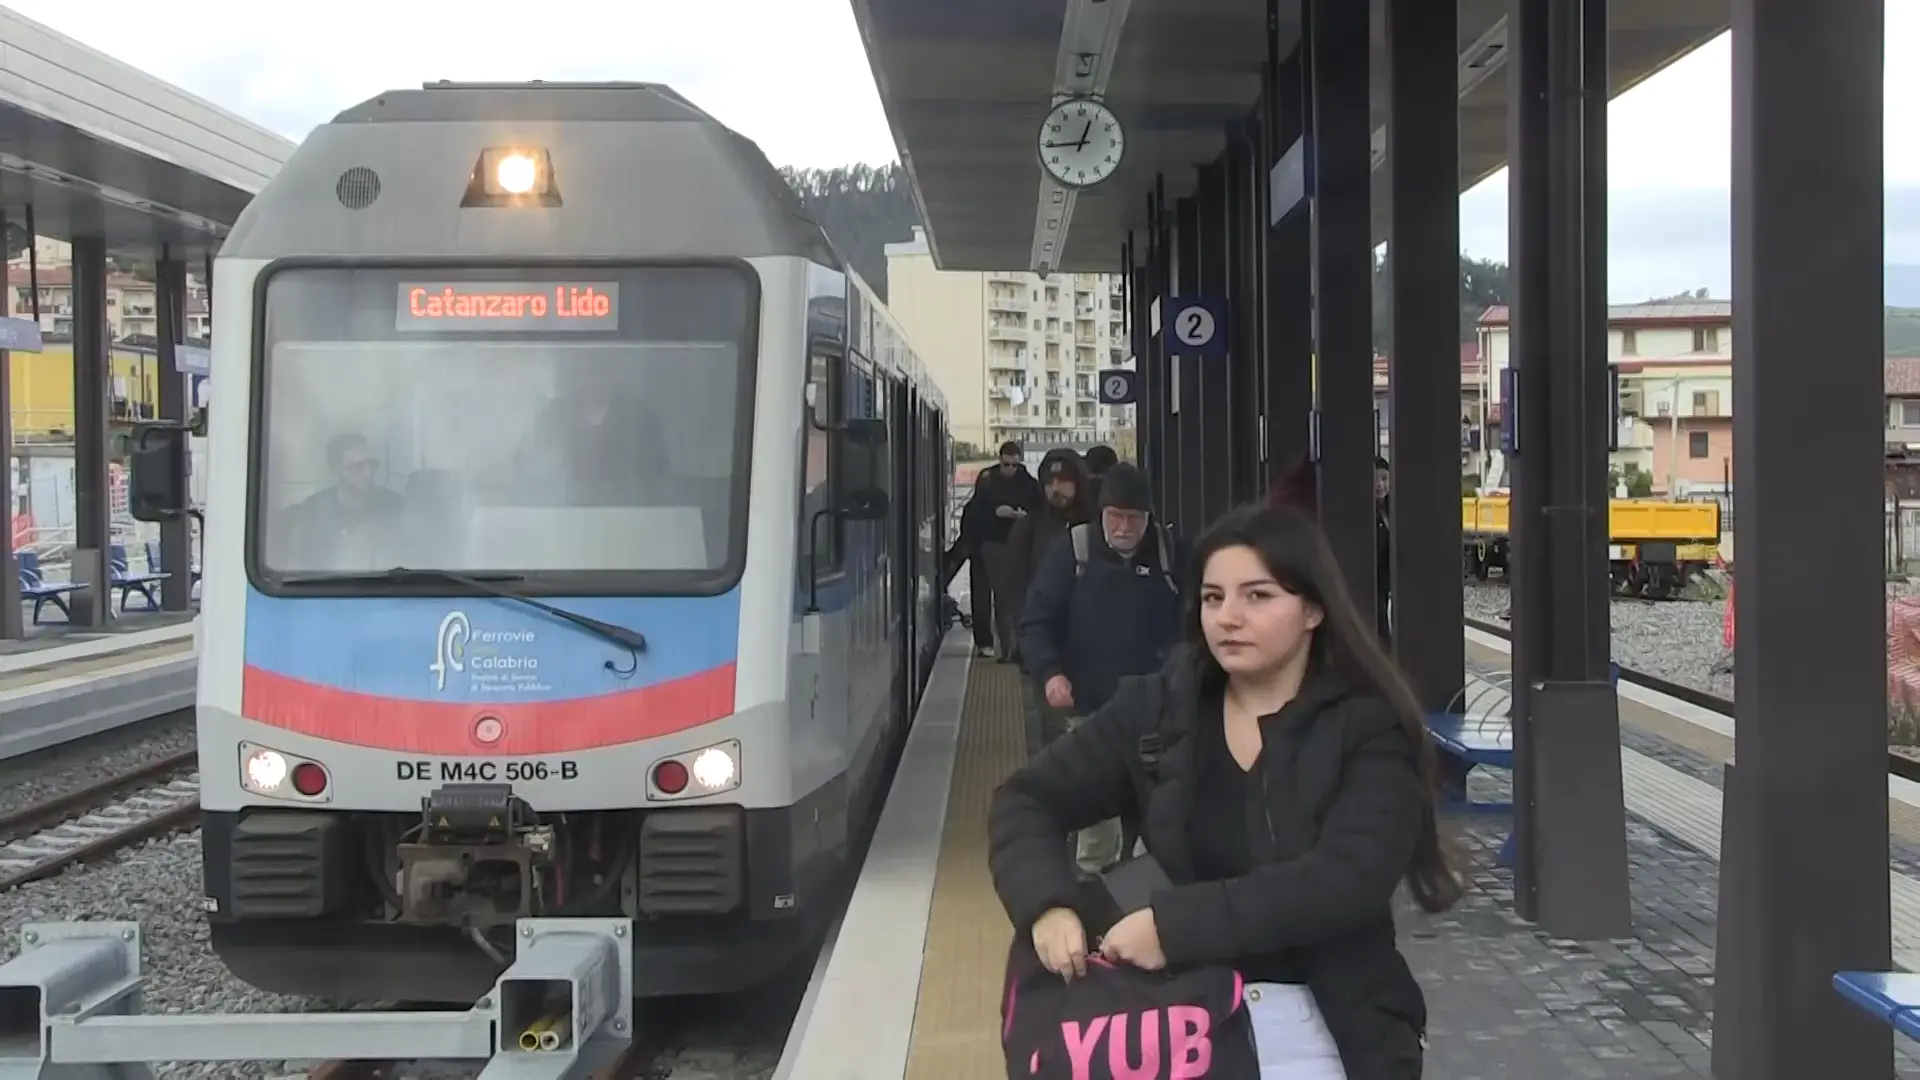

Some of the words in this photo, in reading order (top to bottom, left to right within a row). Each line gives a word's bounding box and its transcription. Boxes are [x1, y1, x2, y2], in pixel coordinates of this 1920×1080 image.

[410, 287, 547, 317] Catanzaro
[556, 286, 609, 317] Lido
[1187, 313, 1202, 339] 2
[1111, 380, 1120, 395] 2
[472, 630, 535, 642] Ferrovie
[471, 656, 538, 669] Calabria
[397, 761, 431, 780] DE
[441, 761, 497, 781] M4C
[505, 761, 578, 780] 506-B
[1061, 1005, 1212, 1080] YUB
